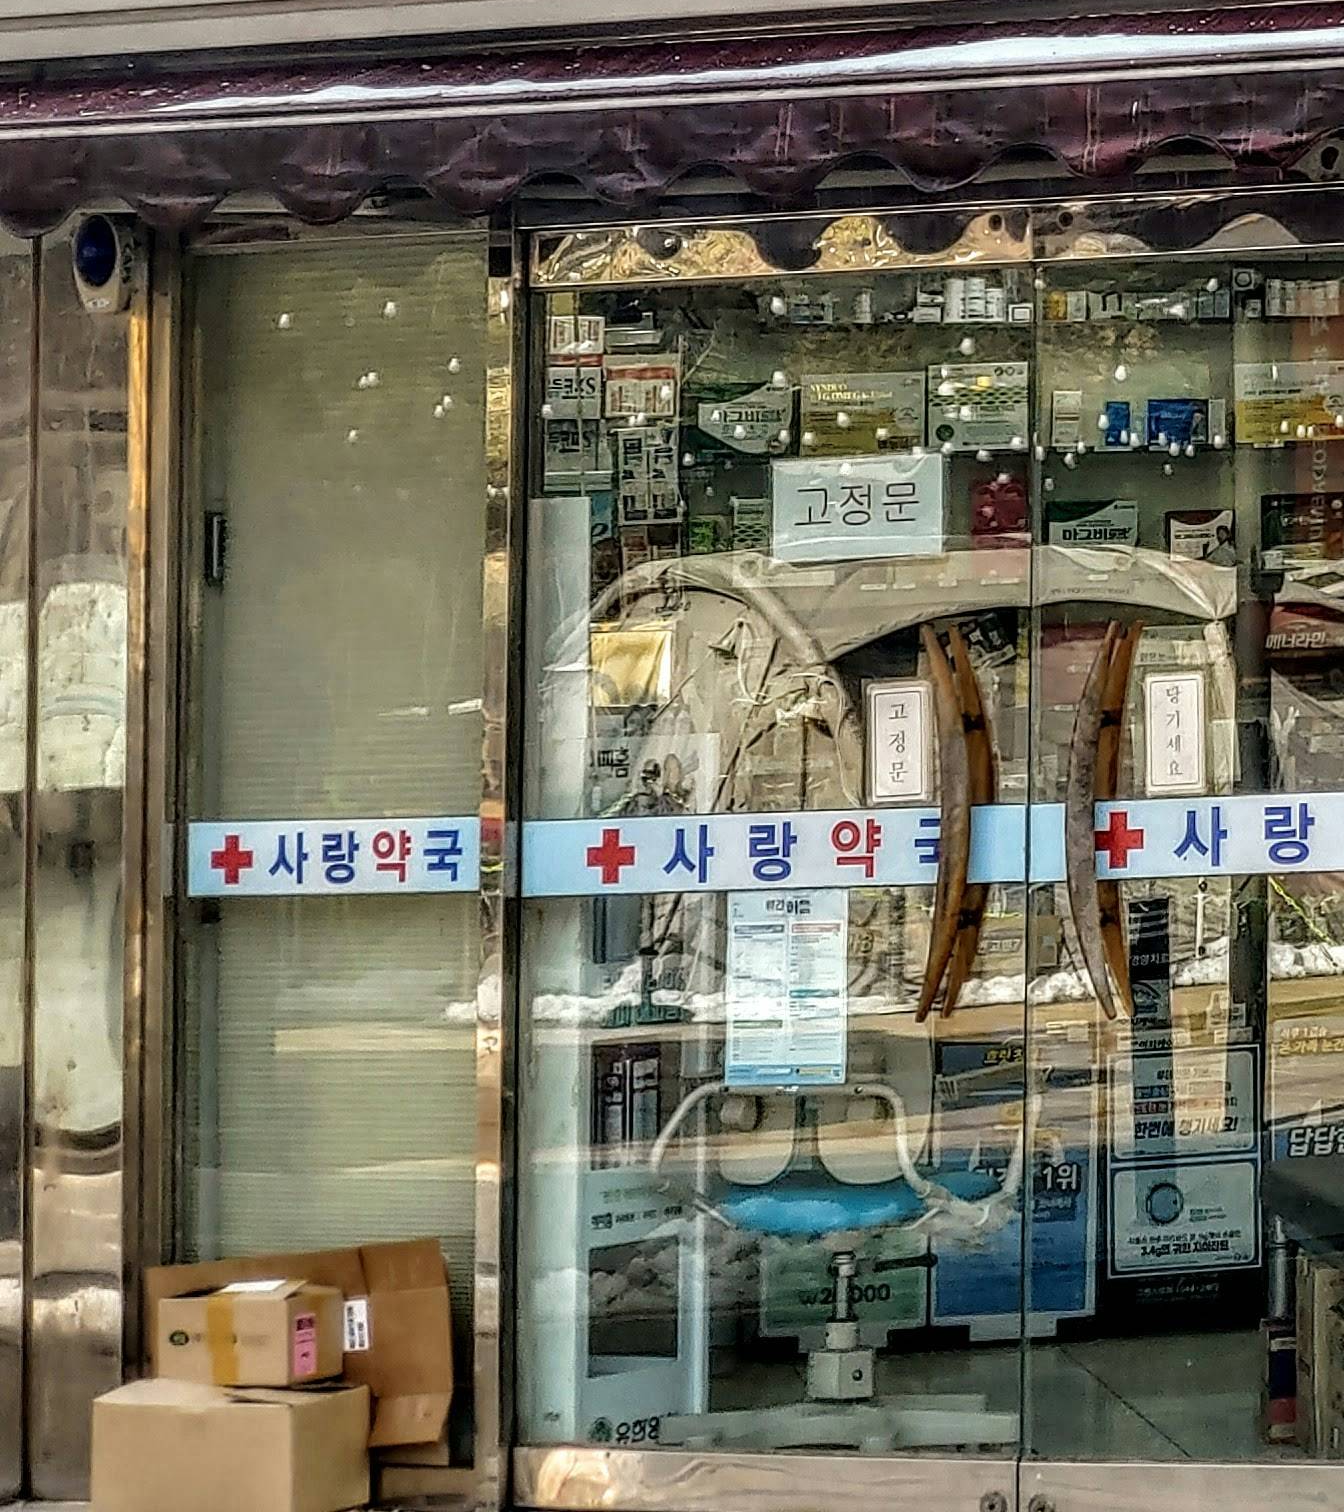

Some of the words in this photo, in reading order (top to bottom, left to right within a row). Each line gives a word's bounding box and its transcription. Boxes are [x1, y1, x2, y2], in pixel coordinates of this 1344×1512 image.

[793, 481, 921, 527] 고정문
[887, 701, 910, 784] 고정문
[1165, 684, 1184, 778] 당기세요
[268, 829, 464, 885] 사랑약국
